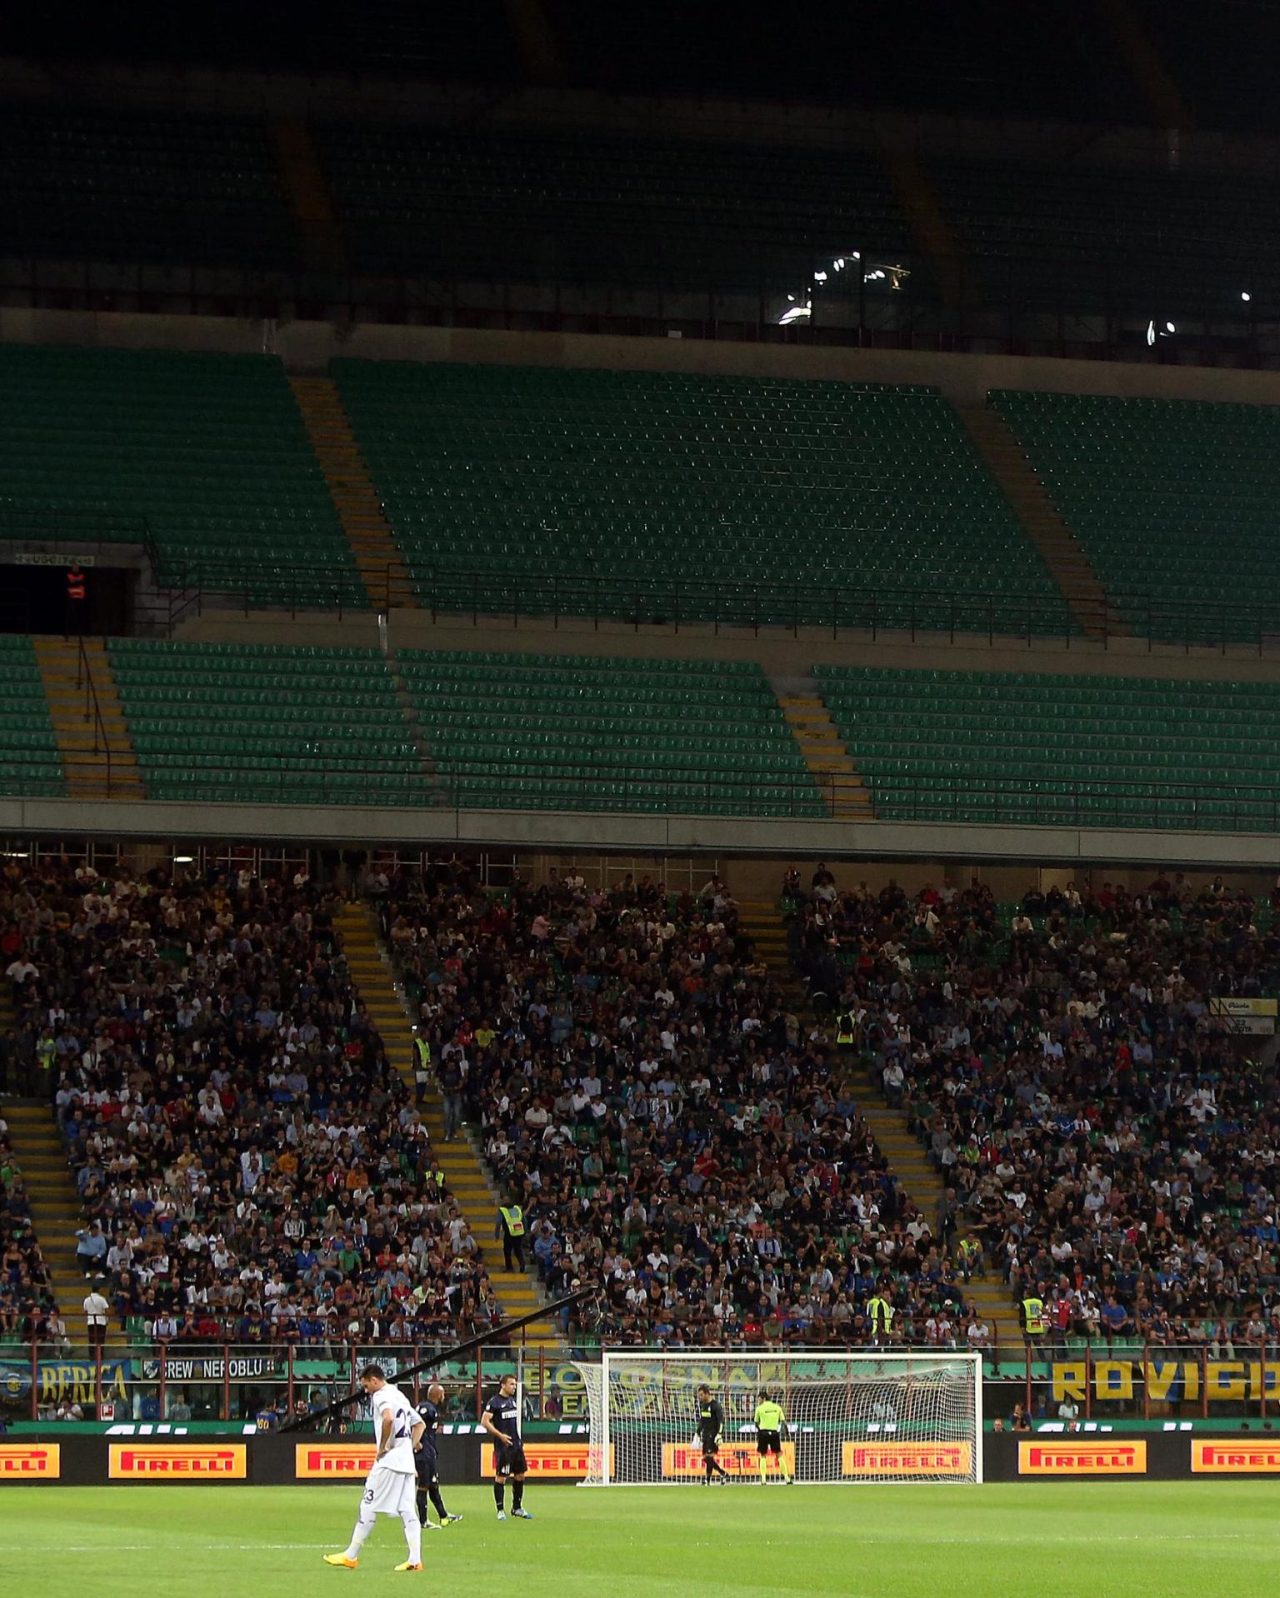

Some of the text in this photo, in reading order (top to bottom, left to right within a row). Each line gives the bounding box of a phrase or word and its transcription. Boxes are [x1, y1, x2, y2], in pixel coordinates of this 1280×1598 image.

[120, 1451, 234, 1471] PIRELLI
[854, 1448, 961, 1468] PIRELLI
[1029, 1448, 1135, 1467] PIRELLI
